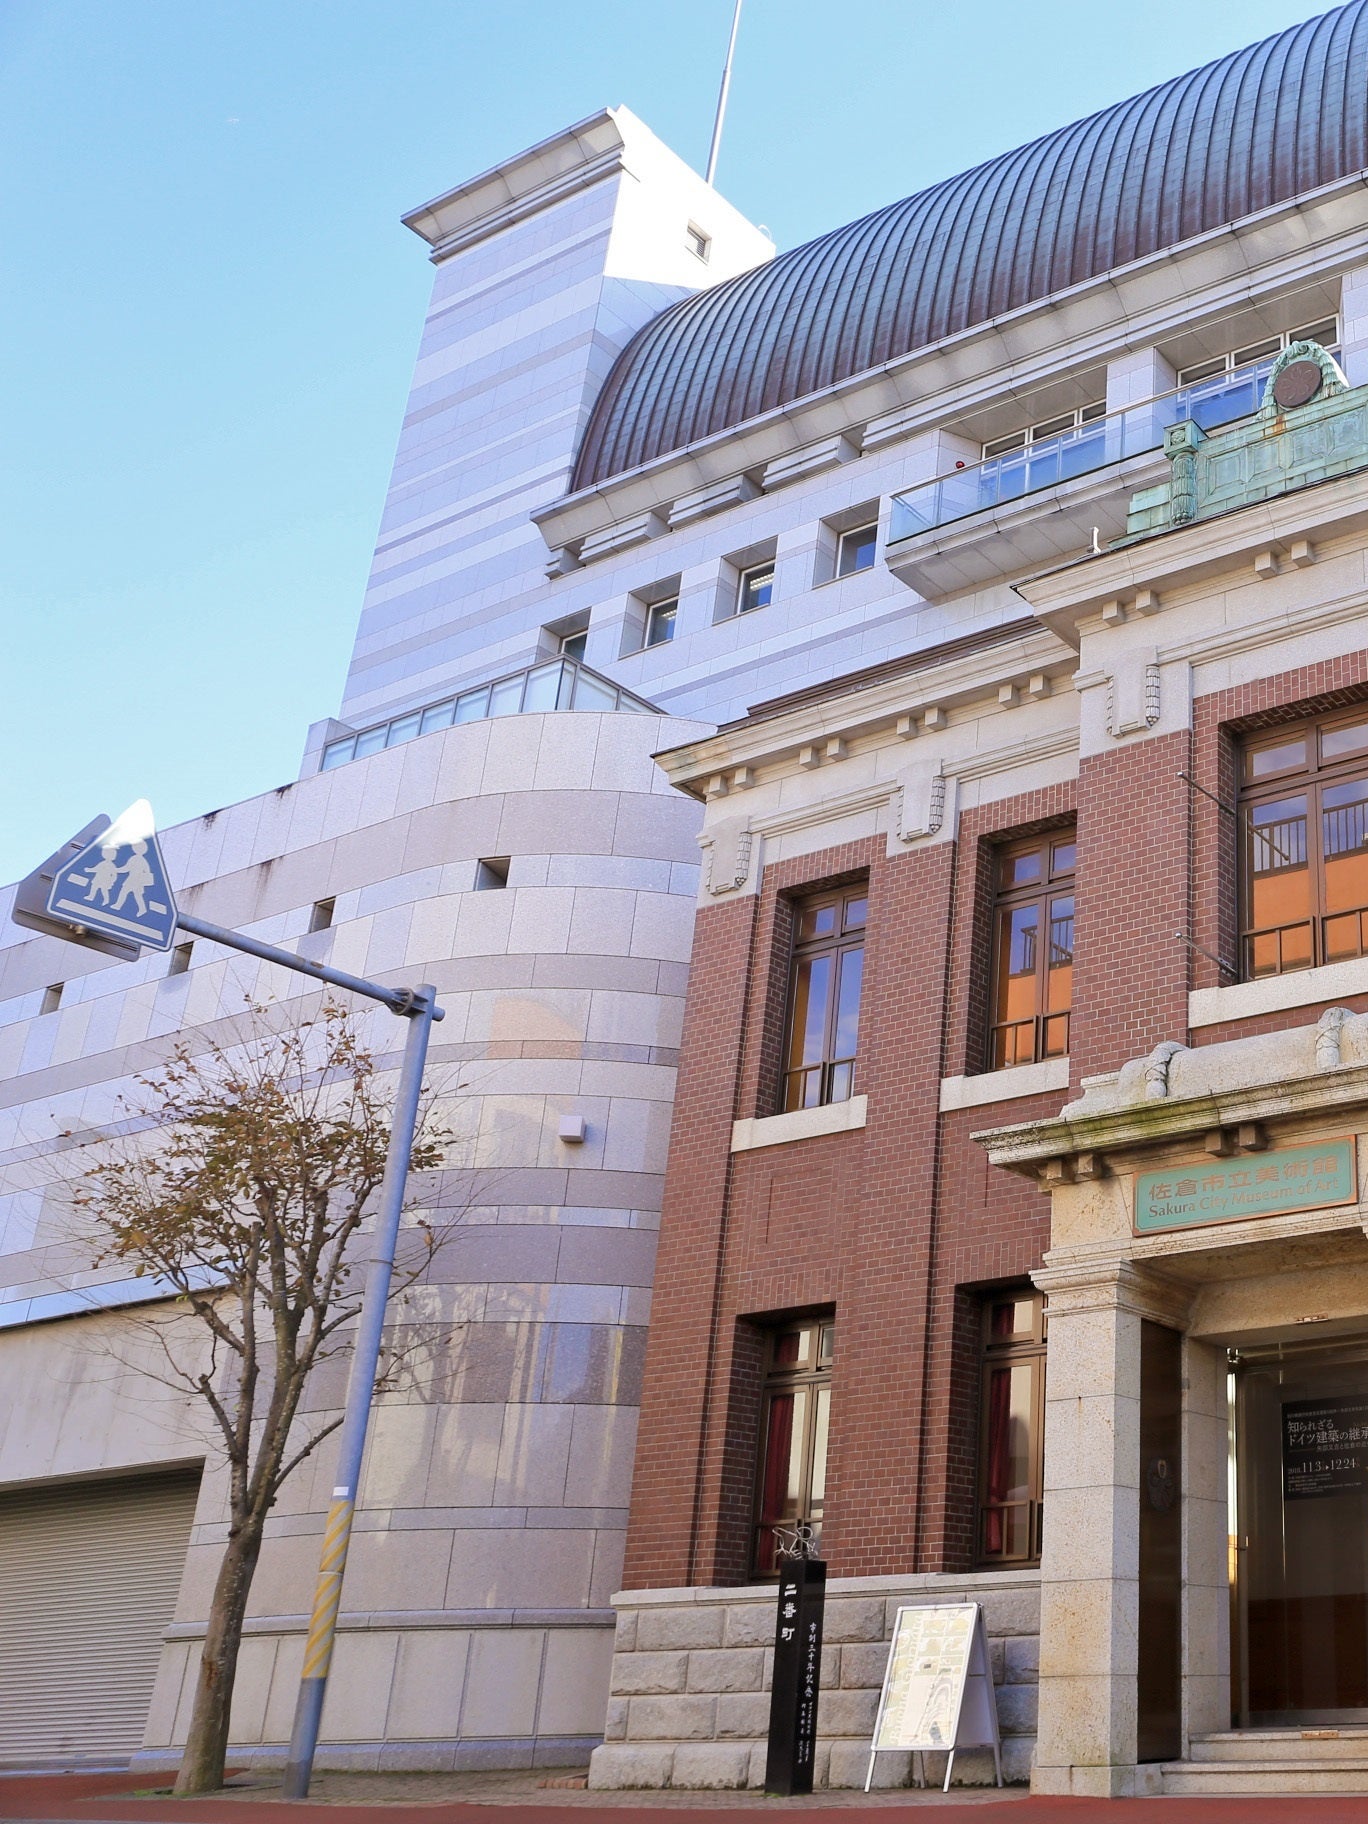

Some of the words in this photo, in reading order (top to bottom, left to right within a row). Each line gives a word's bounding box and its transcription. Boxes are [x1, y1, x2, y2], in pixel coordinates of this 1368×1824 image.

[1149, 1156, 1337, 1200] 佐倉市立美術館
[1149, 1202, 1195, 1218] Sakura
[1199, 1195, 1228, 1210] City
[1231, 1187, 1293, 1205] Museum
[1297, 1180, 1312, 1194] of
[1314, 1177, 1340, 1192] Art
[1288, 1419, 1334, 1433] 知られざる
[781, 1583, 797, 1640] 二番町
